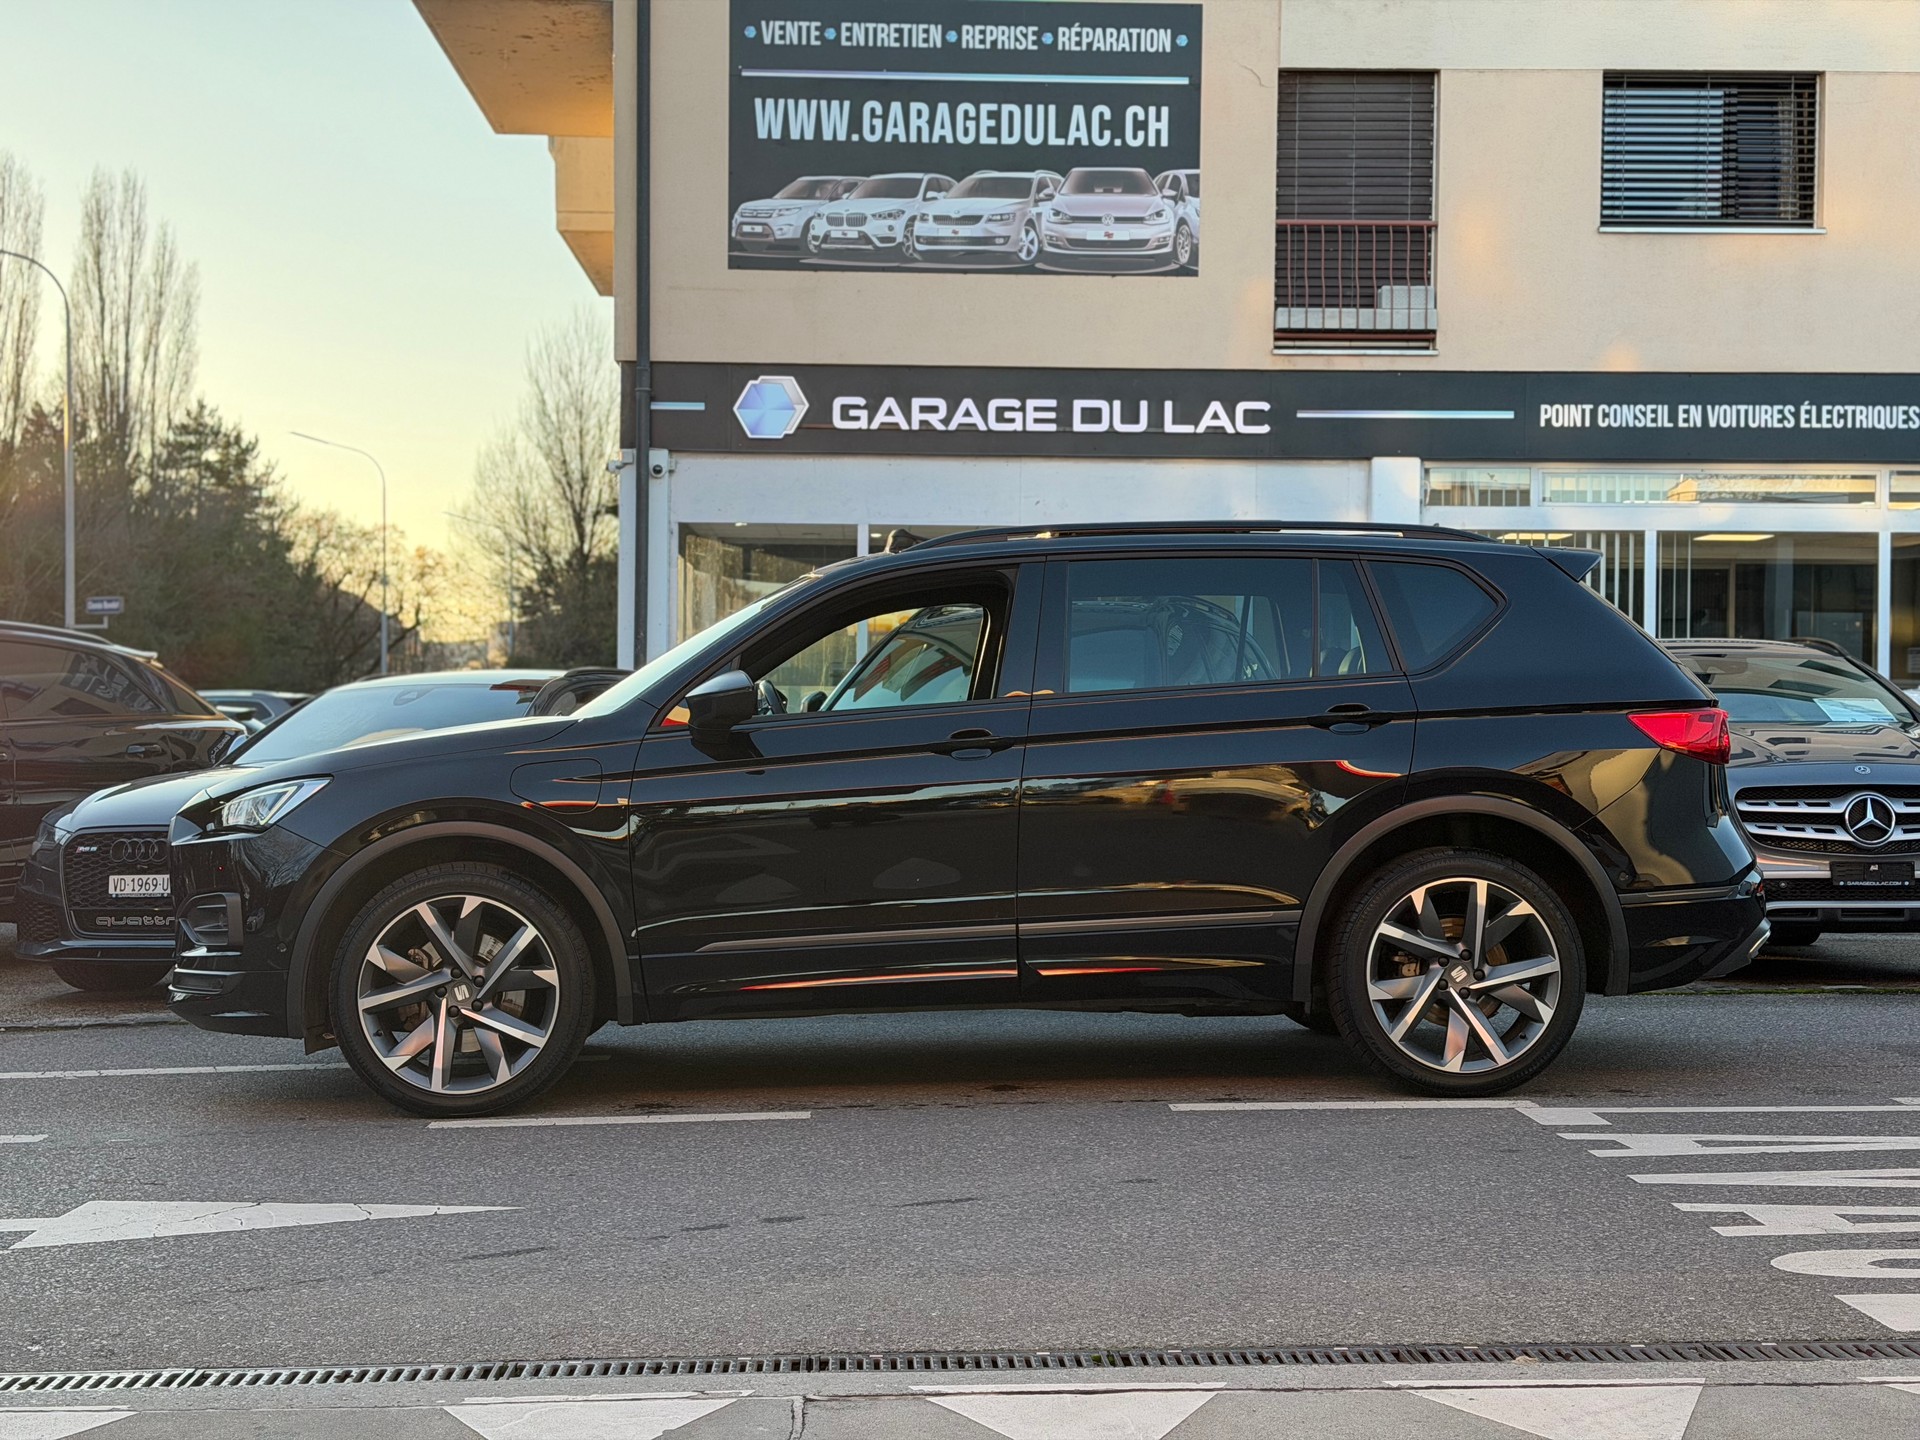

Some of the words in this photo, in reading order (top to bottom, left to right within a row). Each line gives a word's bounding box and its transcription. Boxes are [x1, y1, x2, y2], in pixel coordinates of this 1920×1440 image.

[761, 21, 821, 46] VENTE
[841, 22, 942, 48] ENTRETIEN
[962, 25, 1038, 50] REPRISE
[1058, 23, 1171, 52] RÉPARATION
[755, 98, 1169, 147] WWW.GARAGEDULAC.CH
[833, 397, 1057, 432] GARAGE
[1073, 400, 1148, 432] DU
[1164, 401, 1271, 434] LAC
[1540, 404, 1593, 427] POINT
[1598, 404, 1673, 428] CONSEIL
[1678, 405, 1702, 427] EN
[1707, 405, 1795, 428] VOITURES
[1800, 401, 1920, 430] ÉLECTRIQUES
[96, 916, 175, 927] quattr
